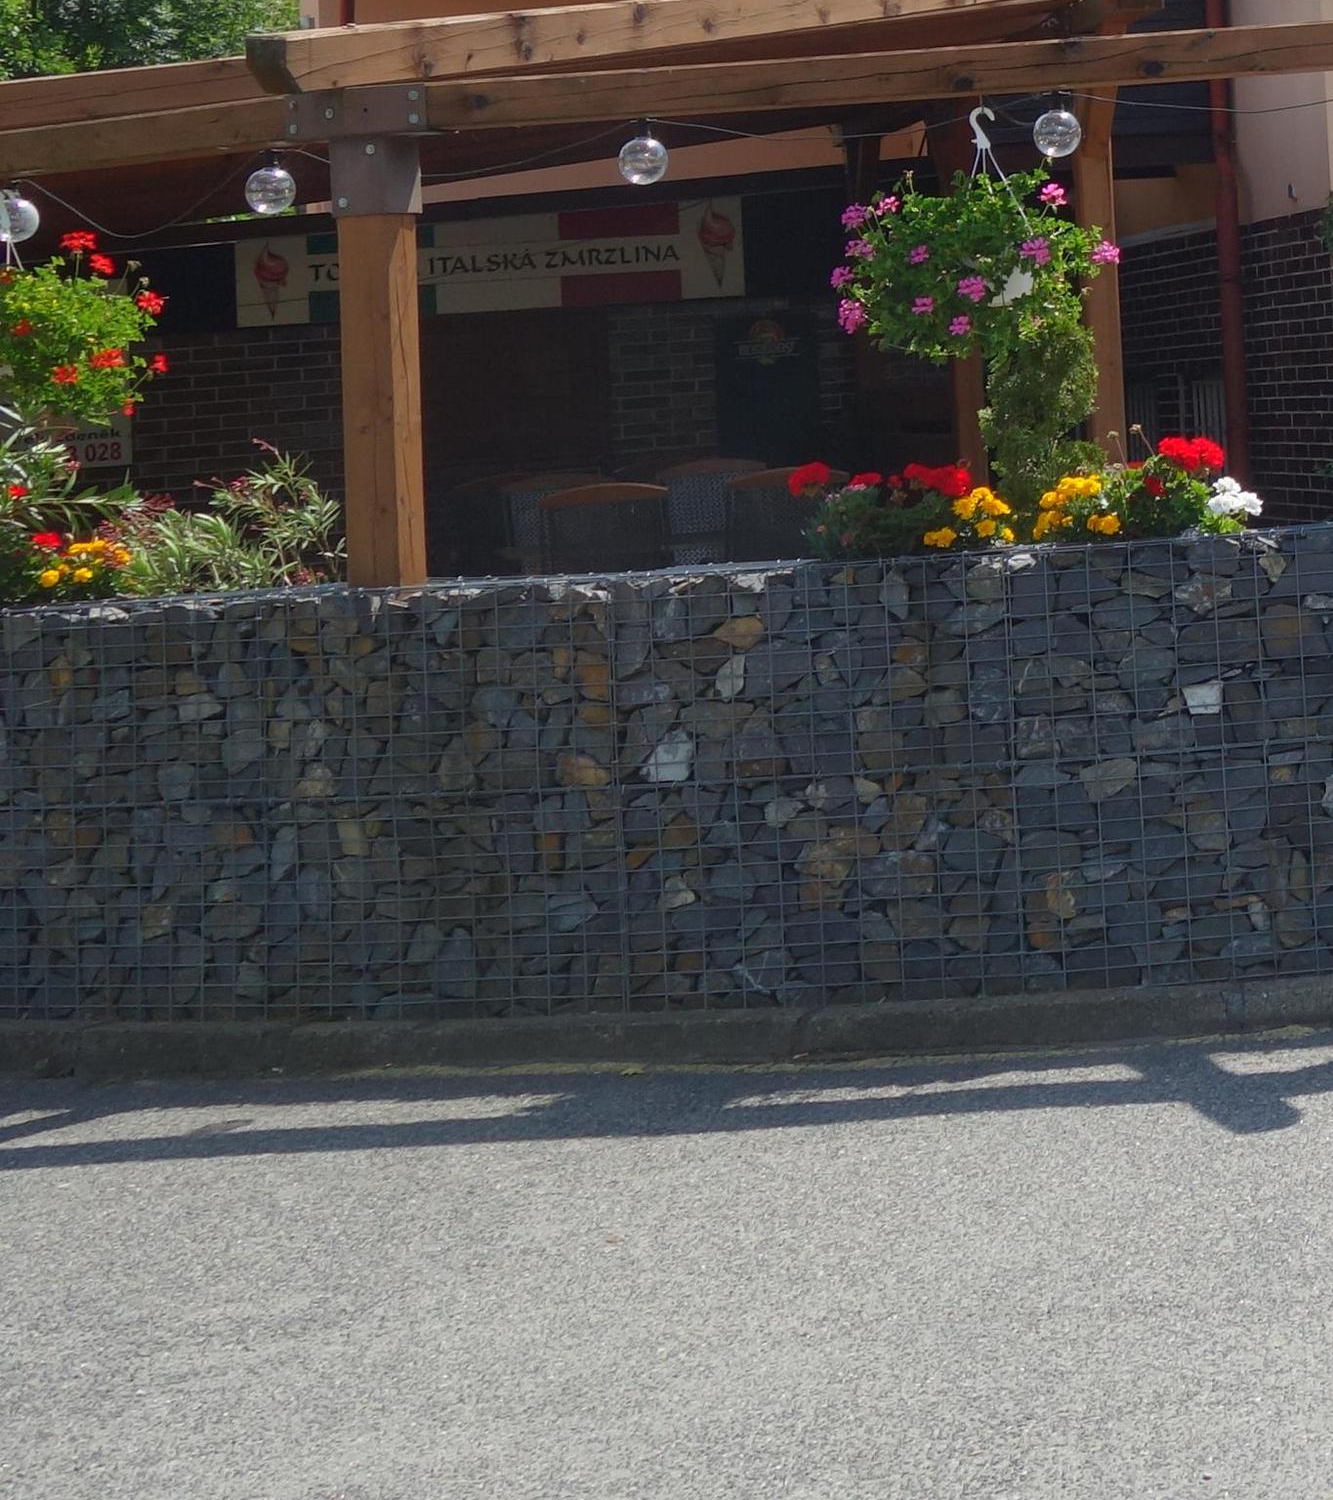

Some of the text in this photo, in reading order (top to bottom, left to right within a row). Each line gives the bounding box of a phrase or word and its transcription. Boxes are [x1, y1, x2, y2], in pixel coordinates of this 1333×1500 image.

[428, 248, 535, 277] ITALSKÁ
[544, 243, 681, 270] ZMRZLINA
[85, 441, 122, 462] 028
